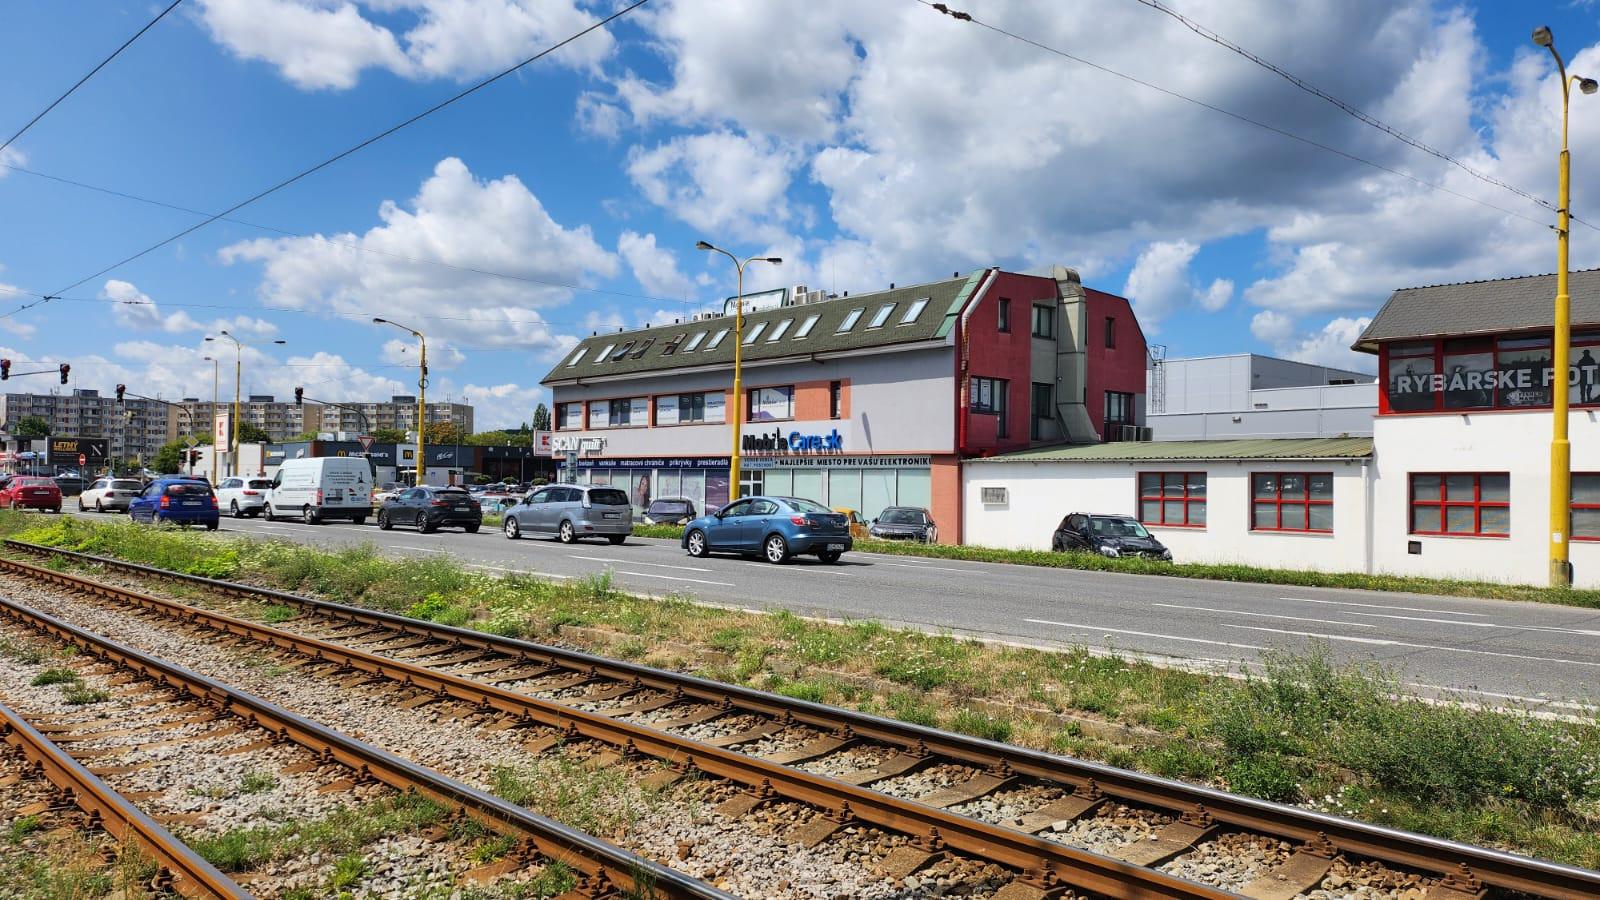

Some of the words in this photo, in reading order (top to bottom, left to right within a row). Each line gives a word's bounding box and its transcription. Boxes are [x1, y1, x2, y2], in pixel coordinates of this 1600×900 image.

[1397, 366, 1532, 393] RYBÁRSKE
[552, 436, 578, 451] SCAN
[779, 457, 814, 466] NAJLEPŠIE
[816, 457, 842, 466] MIESTO
[843, 457, 856, 466] PRE
[858, 456, 878, 466] VAŠU
